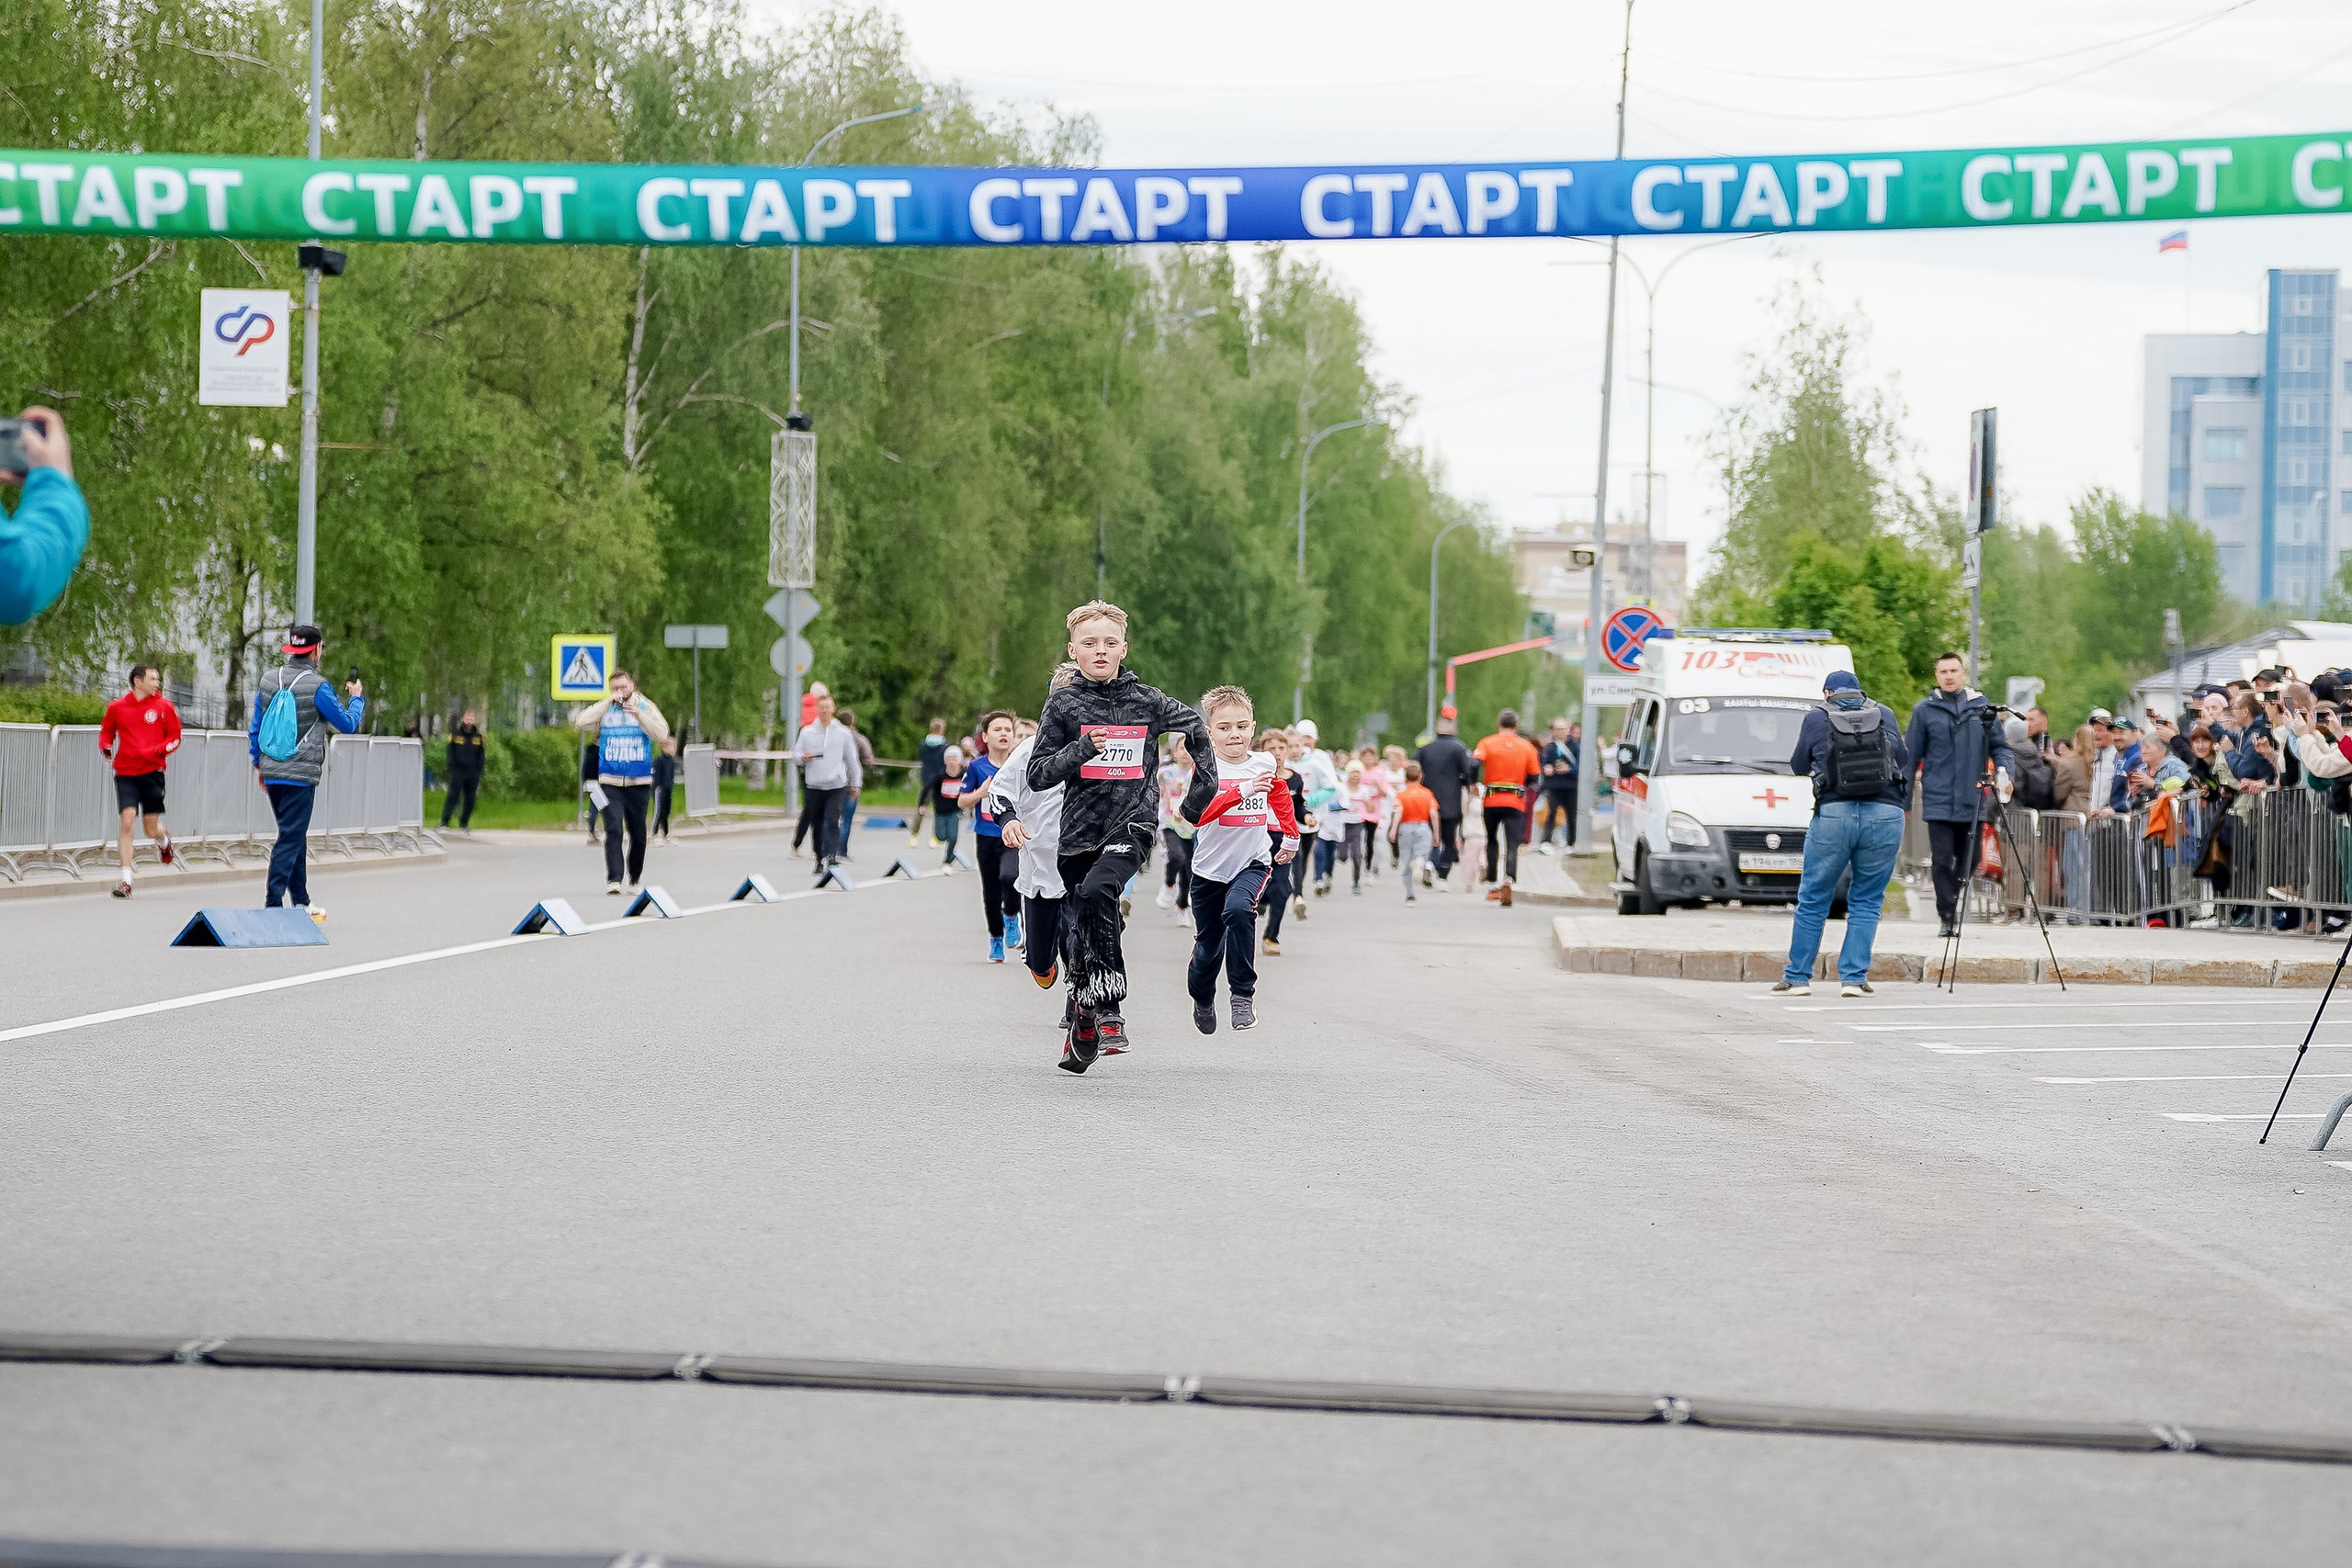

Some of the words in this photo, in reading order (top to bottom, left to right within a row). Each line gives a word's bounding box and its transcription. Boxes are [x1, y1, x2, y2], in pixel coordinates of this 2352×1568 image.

[301, 170, 580, 241] СТАРТ
[637, 176, 912, 243] СТАРТ
[969, 175, 1244, 243] СТАРТ
[1301, 169, 1574, 238] СТАРТ
[1631, 159, 1903, 230] СТАРТ
[1962, 146, 2233, 220] СТАРТ
[2291, 140, 2352, 209] С
[1681, 650, 1740, 671] 103
[1679, 698, 1711, 715] 03
[1100, 748, 1134, 761] 2770
[1237, 797, 1264, 811] 2882
